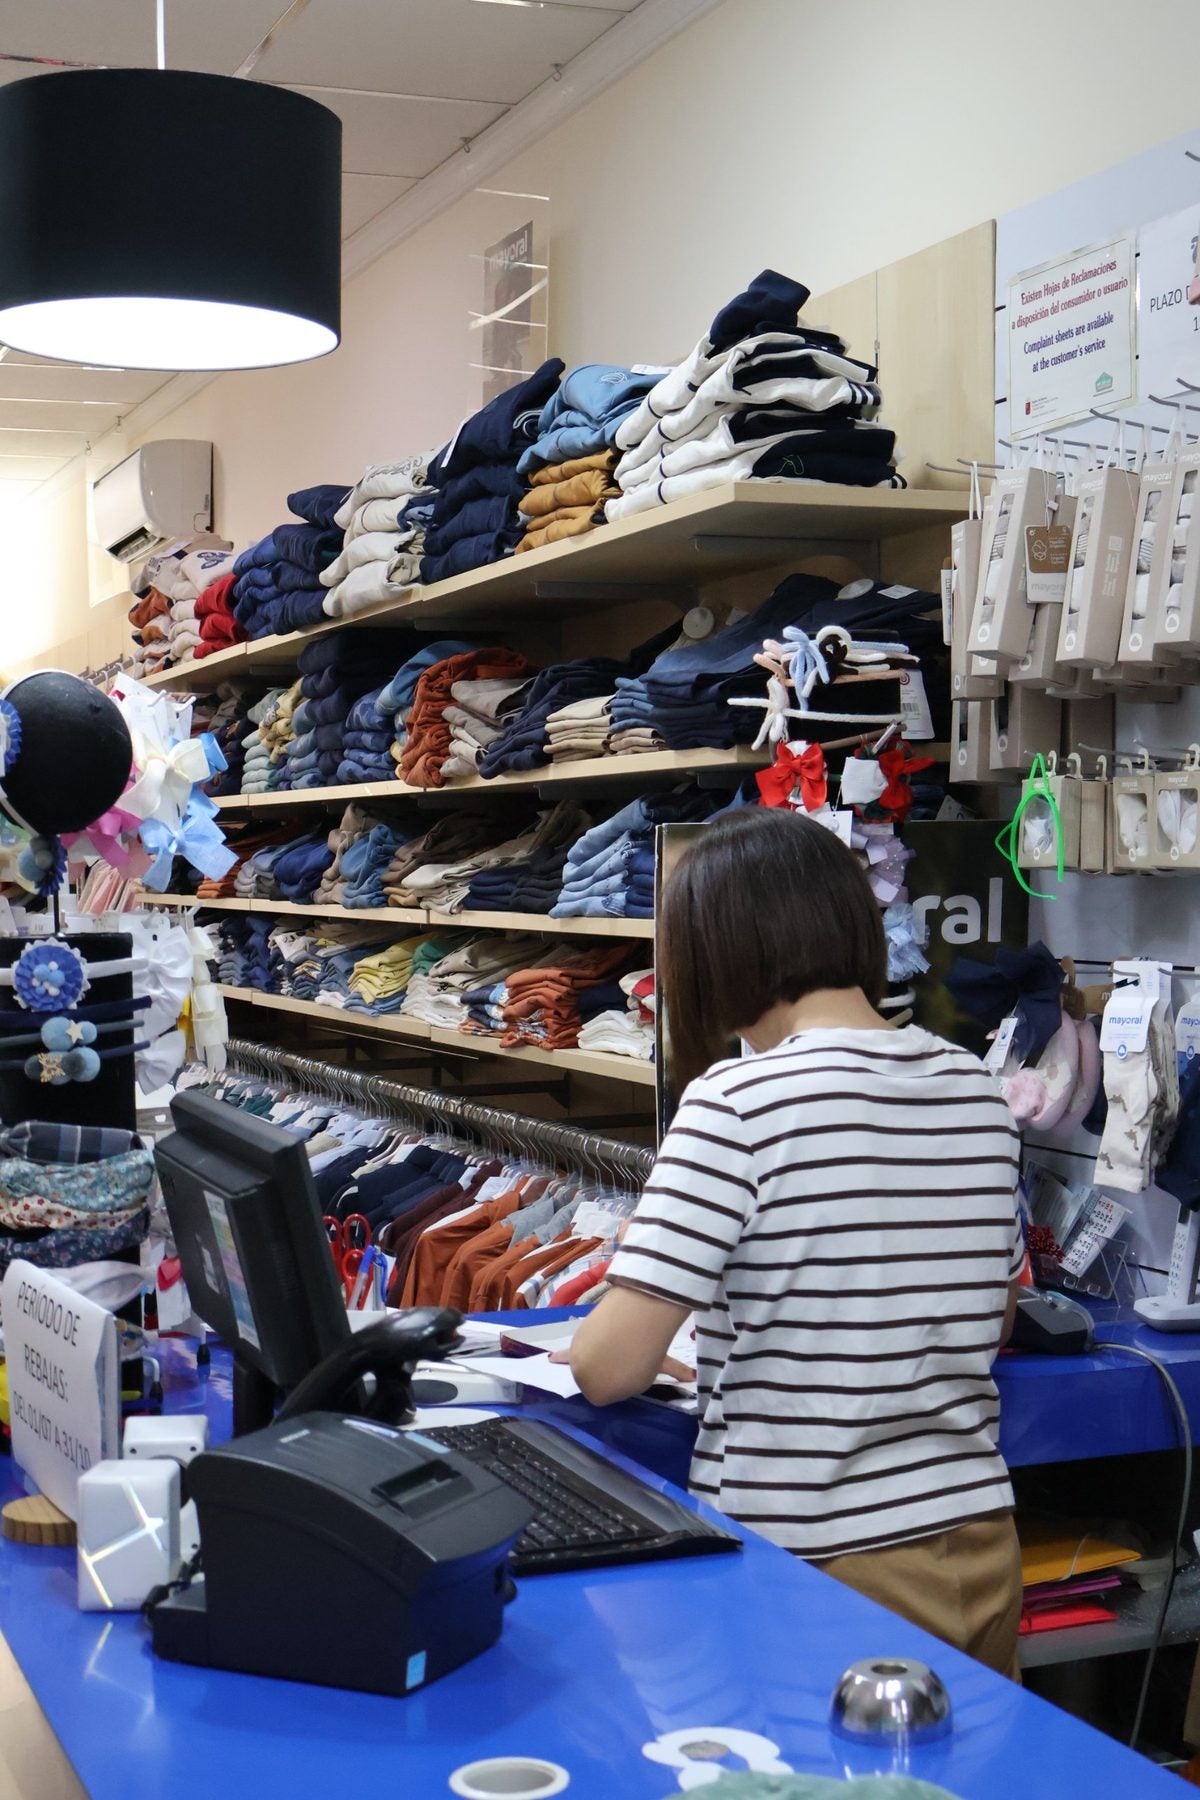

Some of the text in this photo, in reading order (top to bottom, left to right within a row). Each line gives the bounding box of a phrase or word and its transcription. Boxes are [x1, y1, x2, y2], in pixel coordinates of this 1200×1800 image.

[1011, 276, 1128, 330] a disposición del consumidor o usuario
[1020, 260, 1117, 305] Existen Hojas de Reclamaciones
[1150, 288, 1182, 313] PLAZO
[1023, 310, 1114, 354] Complaint sheets are available
[1032, 337, 1106, 373] at the customer's service
[1031, 583, 1065, 592] mayora
[912, 877, 1003, 945] ral
[1109, 1015, 1143, 1026] mayoral
[1181, 1016, 1200, 1027] mayo
[17, 1281, 81, 1347] PERÍODO DE
[24, 1343, 69, 1403] REBAJAS:
[13, 1390, 28, 1425] DEL
[54, 1425, 62, 1452] A
